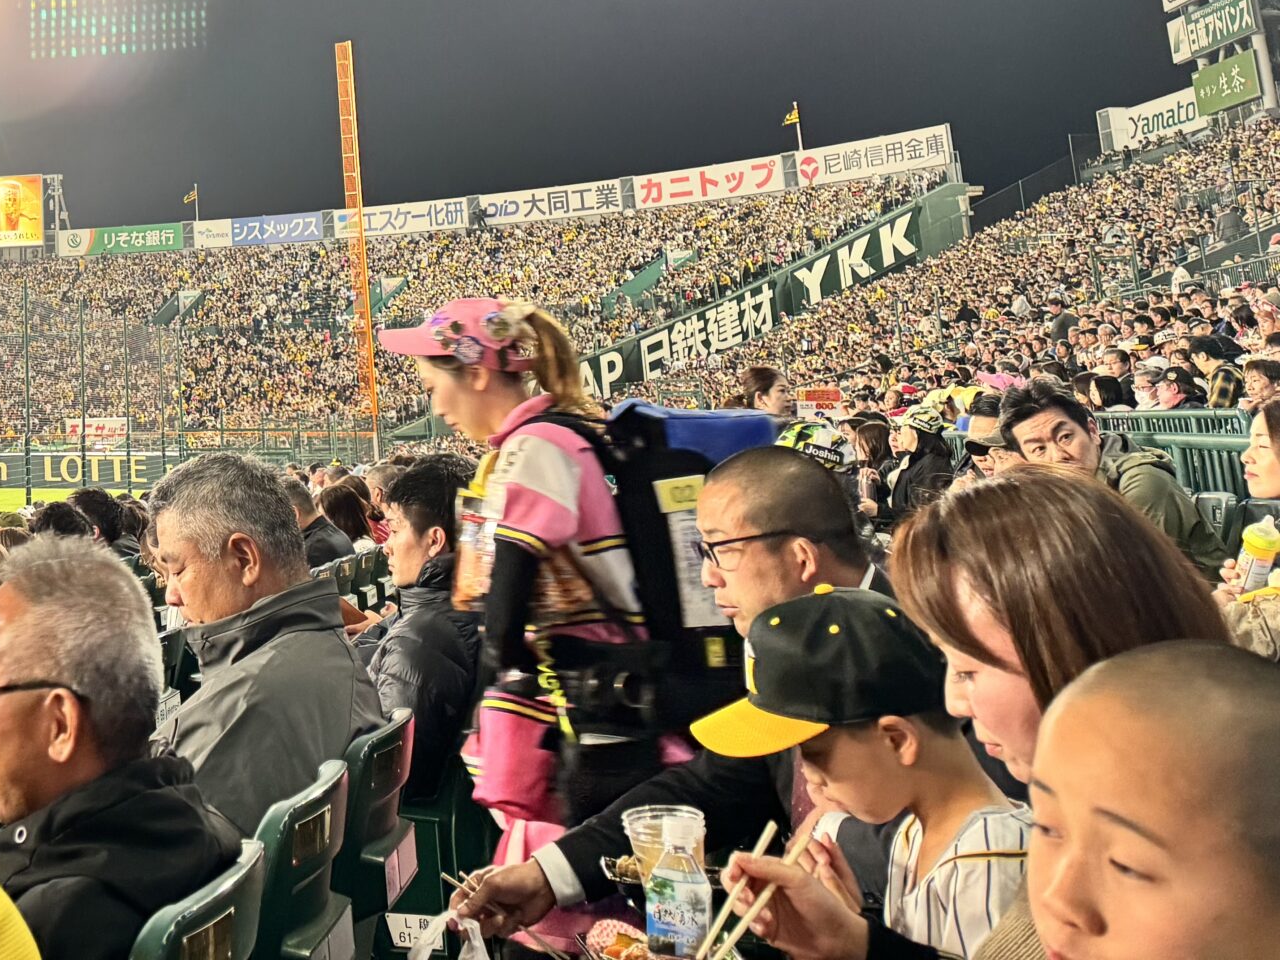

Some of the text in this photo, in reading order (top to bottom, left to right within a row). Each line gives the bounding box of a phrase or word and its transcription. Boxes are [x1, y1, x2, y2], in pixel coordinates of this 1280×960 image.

[1199, 64, 1246, 99] キリン 生茶
[1128, 99, 1196, 139] Yamato
[823, 132, 947, 176] 尼崎信用金庫
[640, 159, 776, 205] カニトップ
[363, 201, 464, 233] エスケー化研
[523, 183, 620, 218] 大同工業
[104, 229, 175, 248] りそな銀行
[233, 218, 318, 241] シスメックス
[794, 211, 918, 306] YKK
[640, 284, 776, 381] 日鉄建材
[44, 455, 148, 483] LOTTE
[805, 443, 840, 463] Joshin
[405, 918, 412, 929] L
